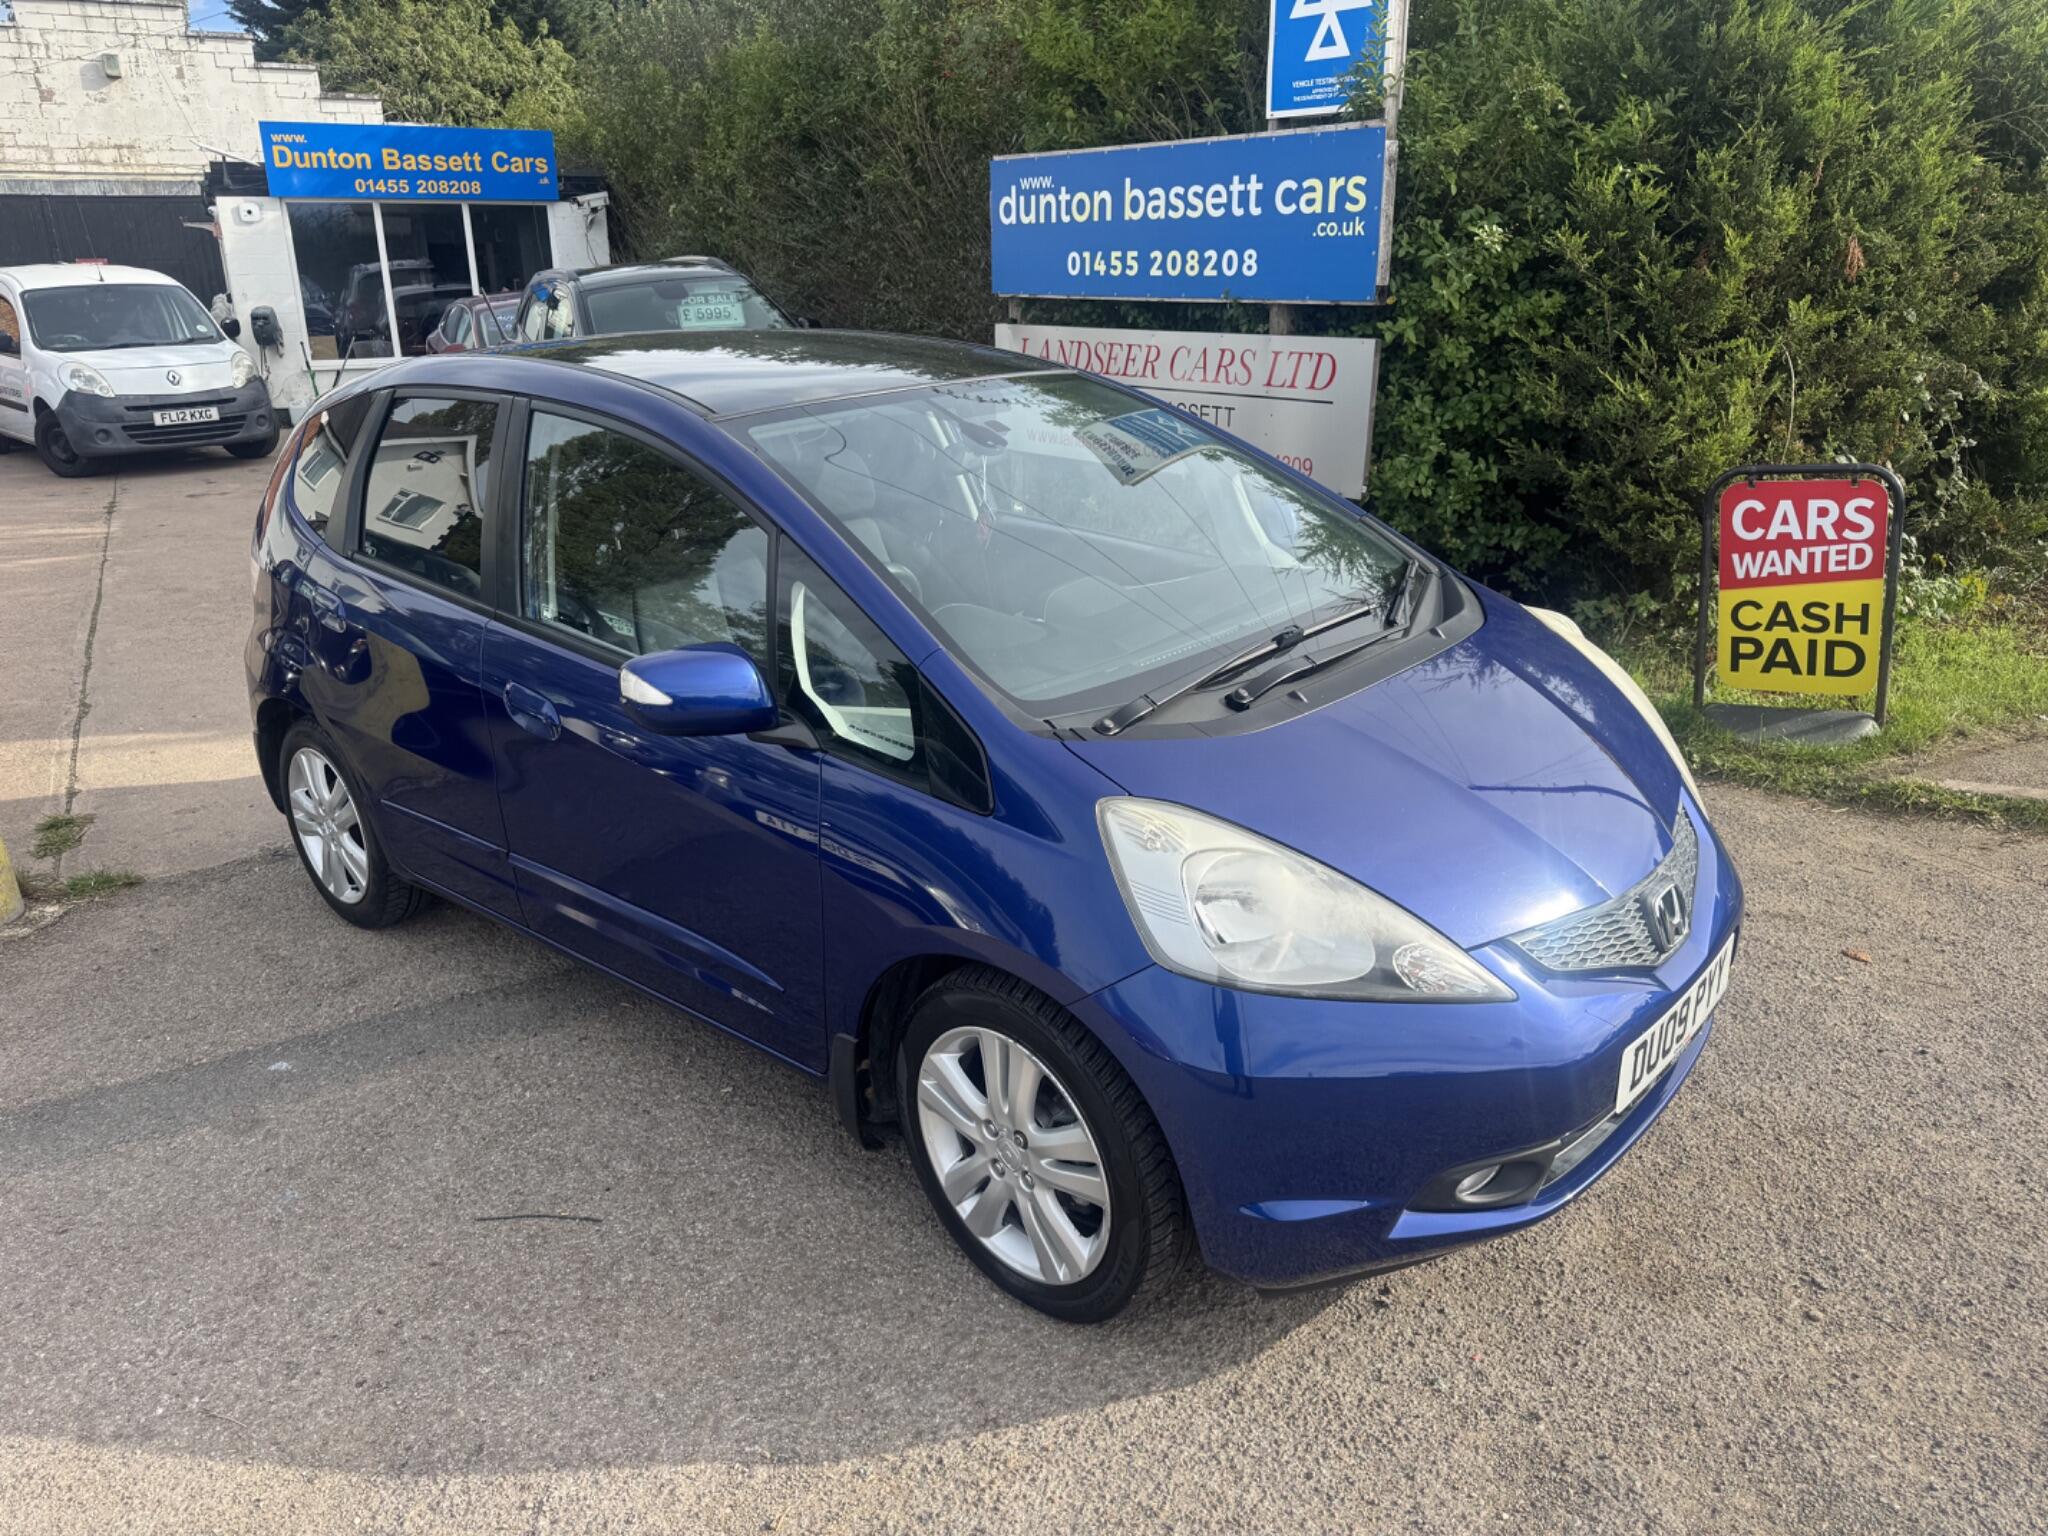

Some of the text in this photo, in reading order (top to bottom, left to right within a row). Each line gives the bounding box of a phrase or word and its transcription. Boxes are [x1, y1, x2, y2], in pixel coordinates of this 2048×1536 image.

[270, 133, 307, 143] www.
[272, 145, 549, 174] Dunton Bassett Cars
[354, 178, 482, 194] 01455 208208
[1020, 176, 1055, 190] www.
[999, 174, 1367, 225] dunton bassett cars
[1312, 216, 1365, 237] .co.uk
[1067, 249, 1258, 277] 01455 208208
[1169, 345, 1256, 386] CARS
[1263, 350, 1337, 390] LTD
[160, 411, 188, 423] FL12
[1731, 498, 1876, 541] CARS
[1731, 543, 1874, 579] WANTED
[1730, 600, 1870, 635] CASH
[1730, 636, 1867, 677] PAID
[1630, 996, 1691, 1092] DU09
